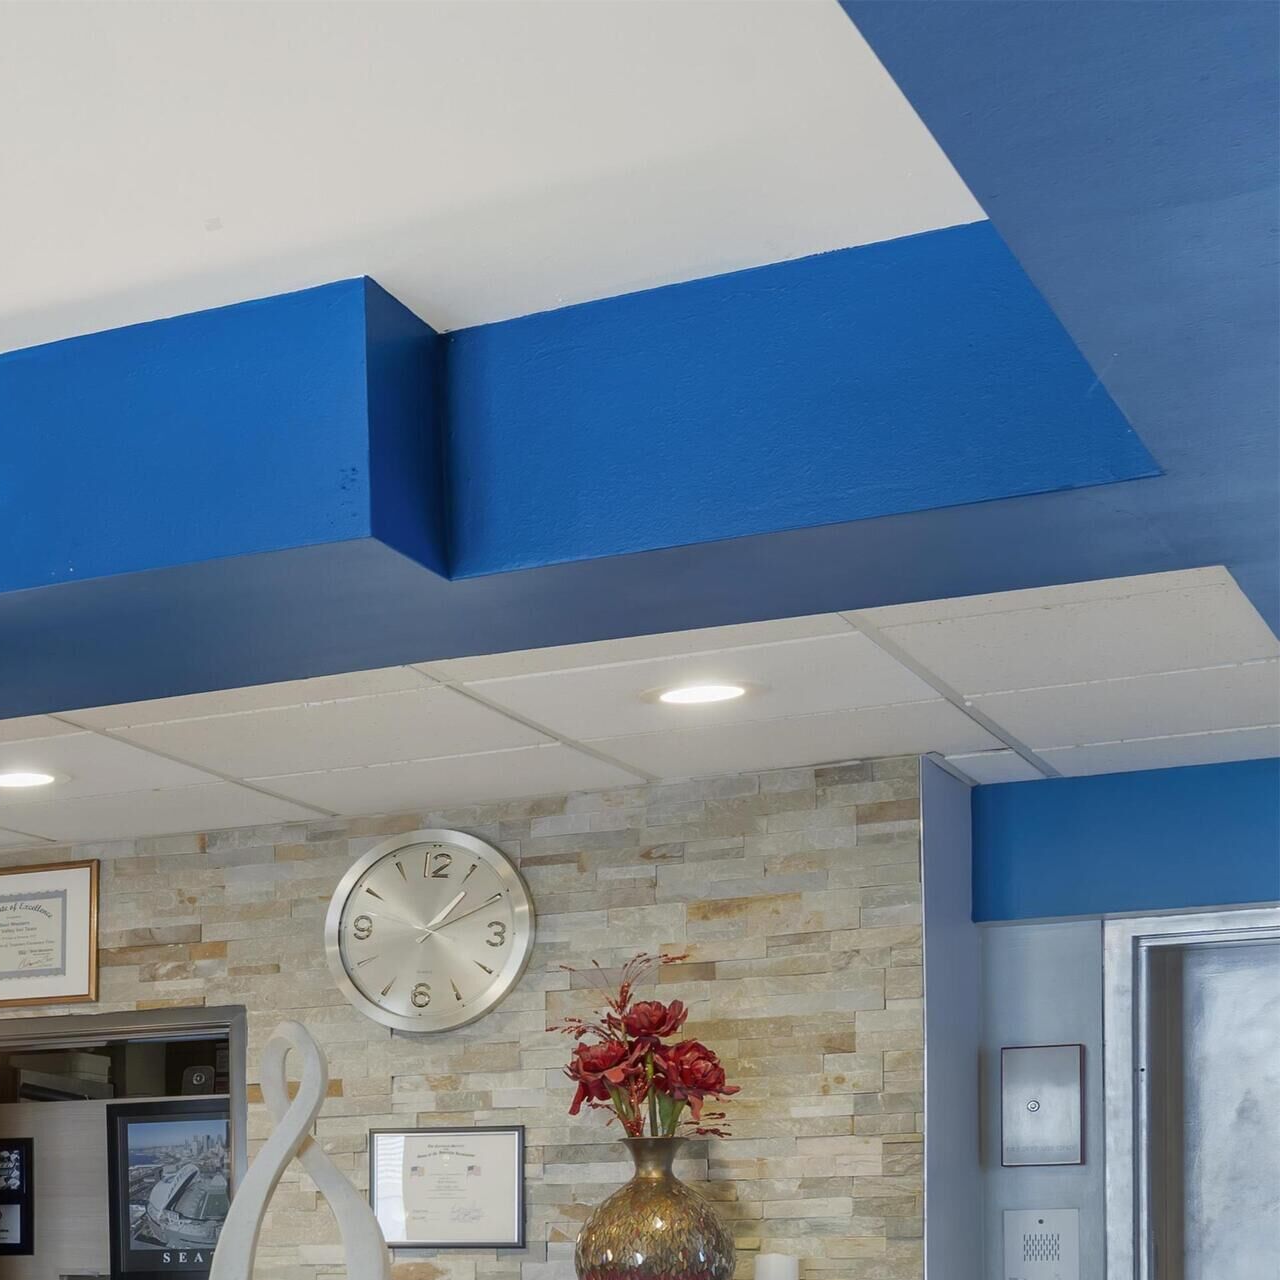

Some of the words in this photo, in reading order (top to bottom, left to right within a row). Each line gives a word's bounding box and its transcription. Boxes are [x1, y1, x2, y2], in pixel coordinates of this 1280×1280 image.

[423, 852, 453, 879] 12
[353, 915, 373, 940] 9
[486, 921, 506, 947] 3
[411, 983, 432, 1008] 6
